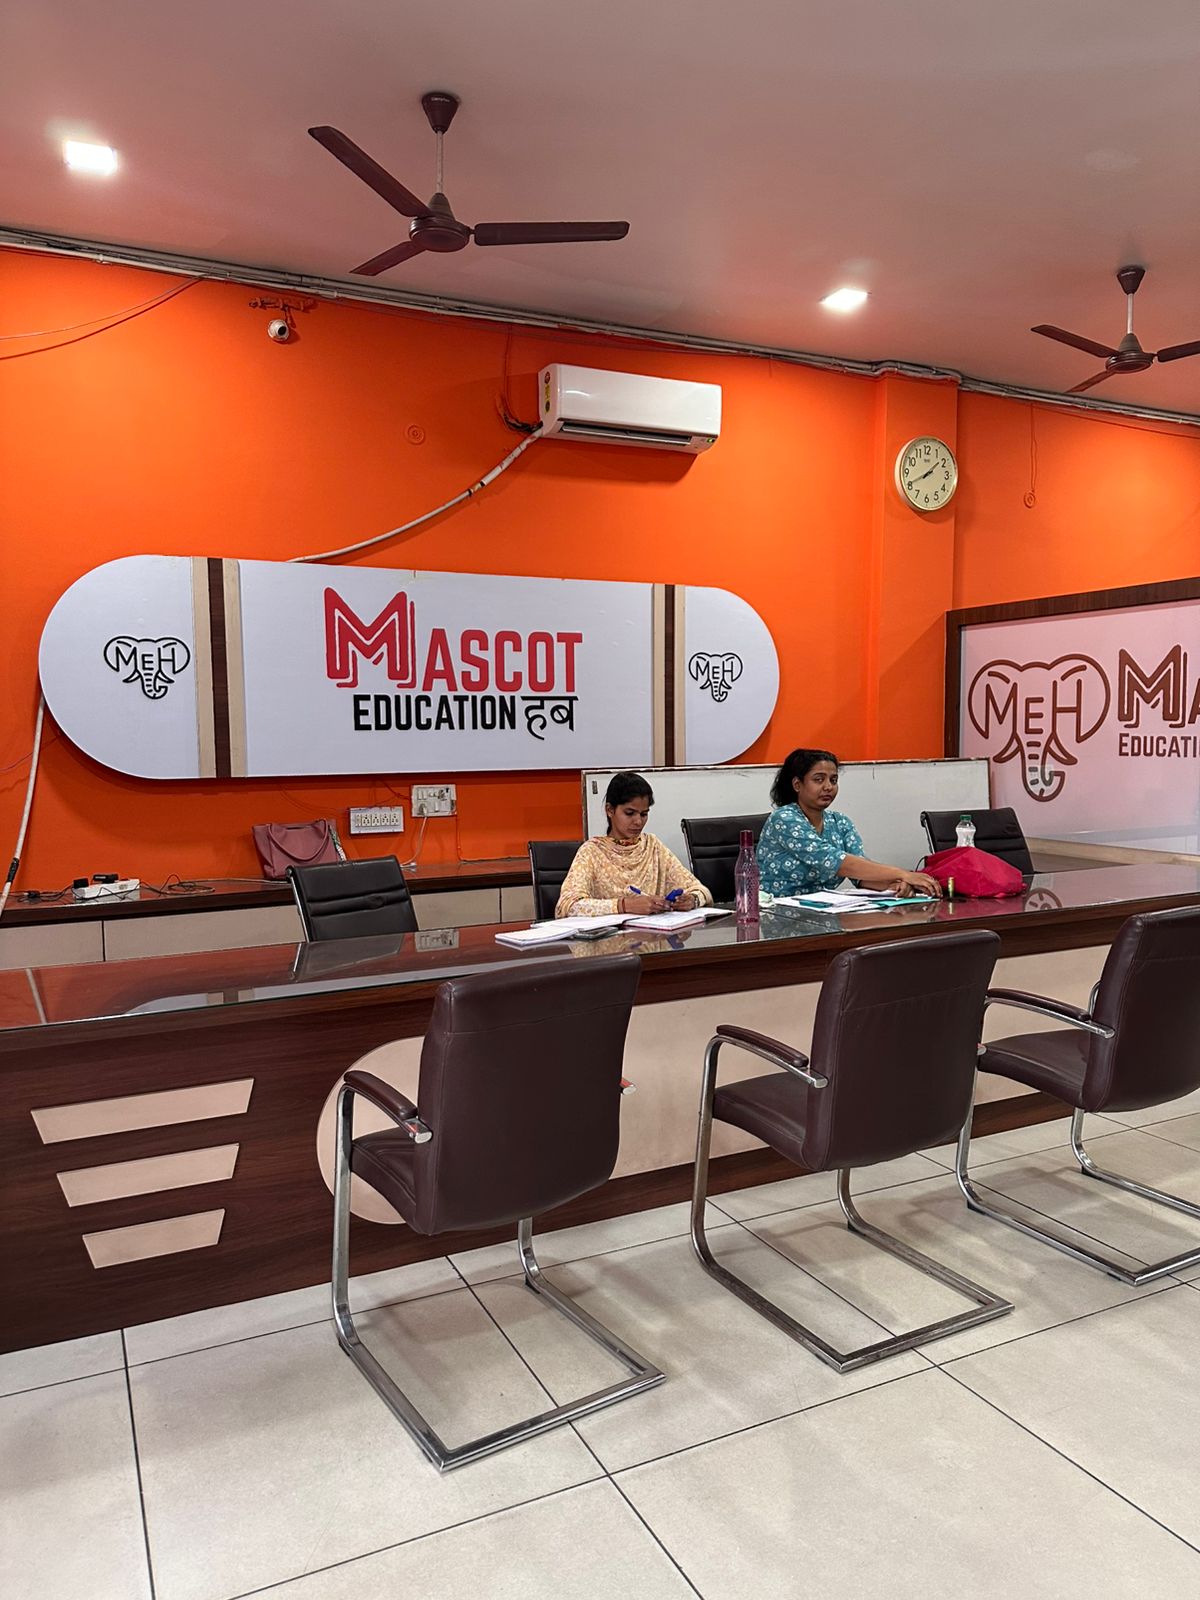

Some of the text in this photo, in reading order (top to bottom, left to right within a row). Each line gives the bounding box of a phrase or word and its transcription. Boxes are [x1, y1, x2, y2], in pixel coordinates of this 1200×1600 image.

[915, 448, 922, 458] 11
[923, 445, 932, 455] 12
[935, 448, 939, 459] 1
[908, 457, 916, 467] 10
[941, 458, 947, 468] 2
[904, 468, 910, 477] 9
[944, 470, 950, 480] 3
[907, 481, 913, 490] 8
[940, 483, 946, 492] 4
[915, 489, 920, 499] 7
[924, 494, 930, 503] 6
[933, 491, 939, 501] 5
[323, 586, 583, 693] MASCOT
[353, 694, 579, 741] EDUCATION हब
[1118, 733, 1200, 758] EDUCATI
